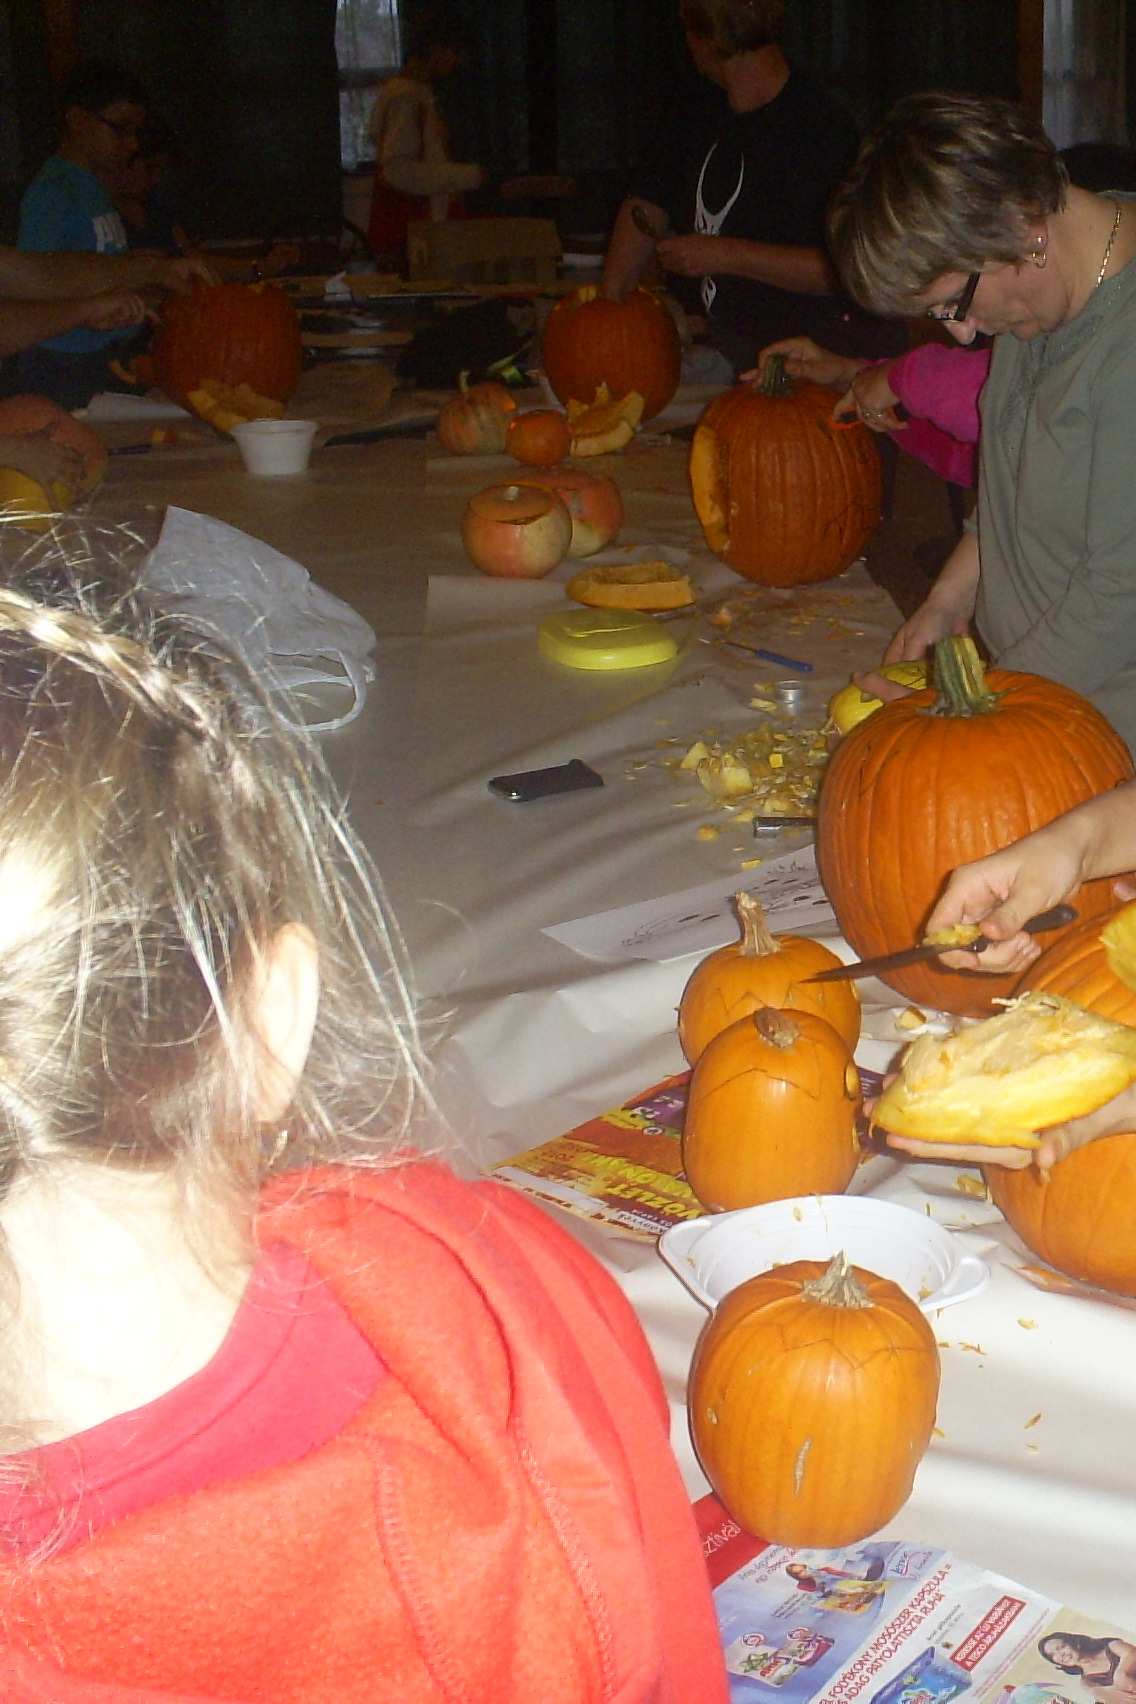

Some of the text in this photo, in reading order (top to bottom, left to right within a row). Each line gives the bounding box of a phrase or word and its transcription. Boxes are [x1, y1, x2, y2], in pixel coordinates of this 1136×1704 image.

[870, 1607, 913, 1653] MOSÓSZER
[909, 1570, 949, 1611] KAPSZULA
[919, 1592, 946, 1618] RUHA
